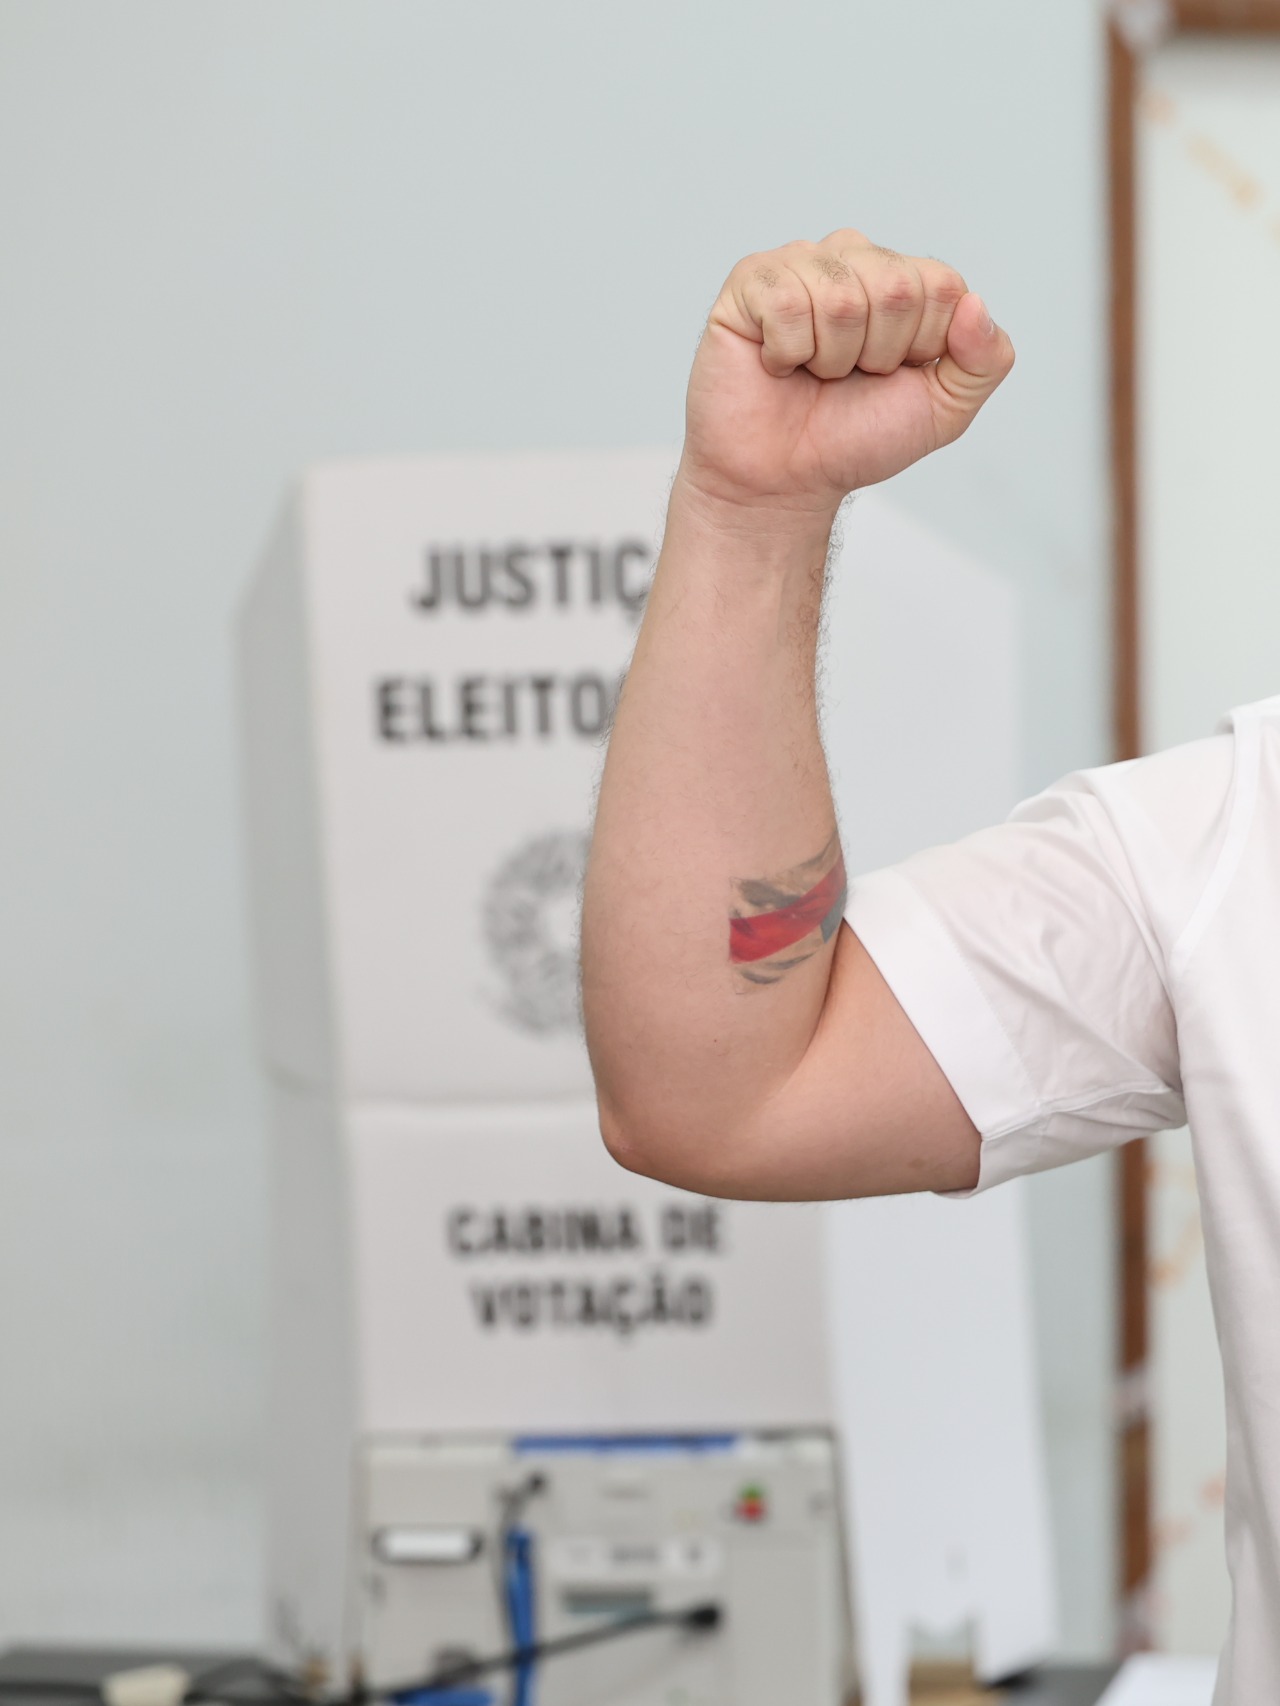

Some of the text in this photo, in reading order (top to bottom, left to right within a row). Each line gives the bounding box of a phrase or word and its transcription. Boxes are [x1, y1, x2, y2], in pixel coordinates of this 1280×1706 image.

[410, 541, 652, 622] JUSTIÇ
[375, 671, 609, 745] ELEITO
[446, 1203, 726, 1259] CABINA DE
[468, 1268, 714, 1342] VOTAÇÃO
